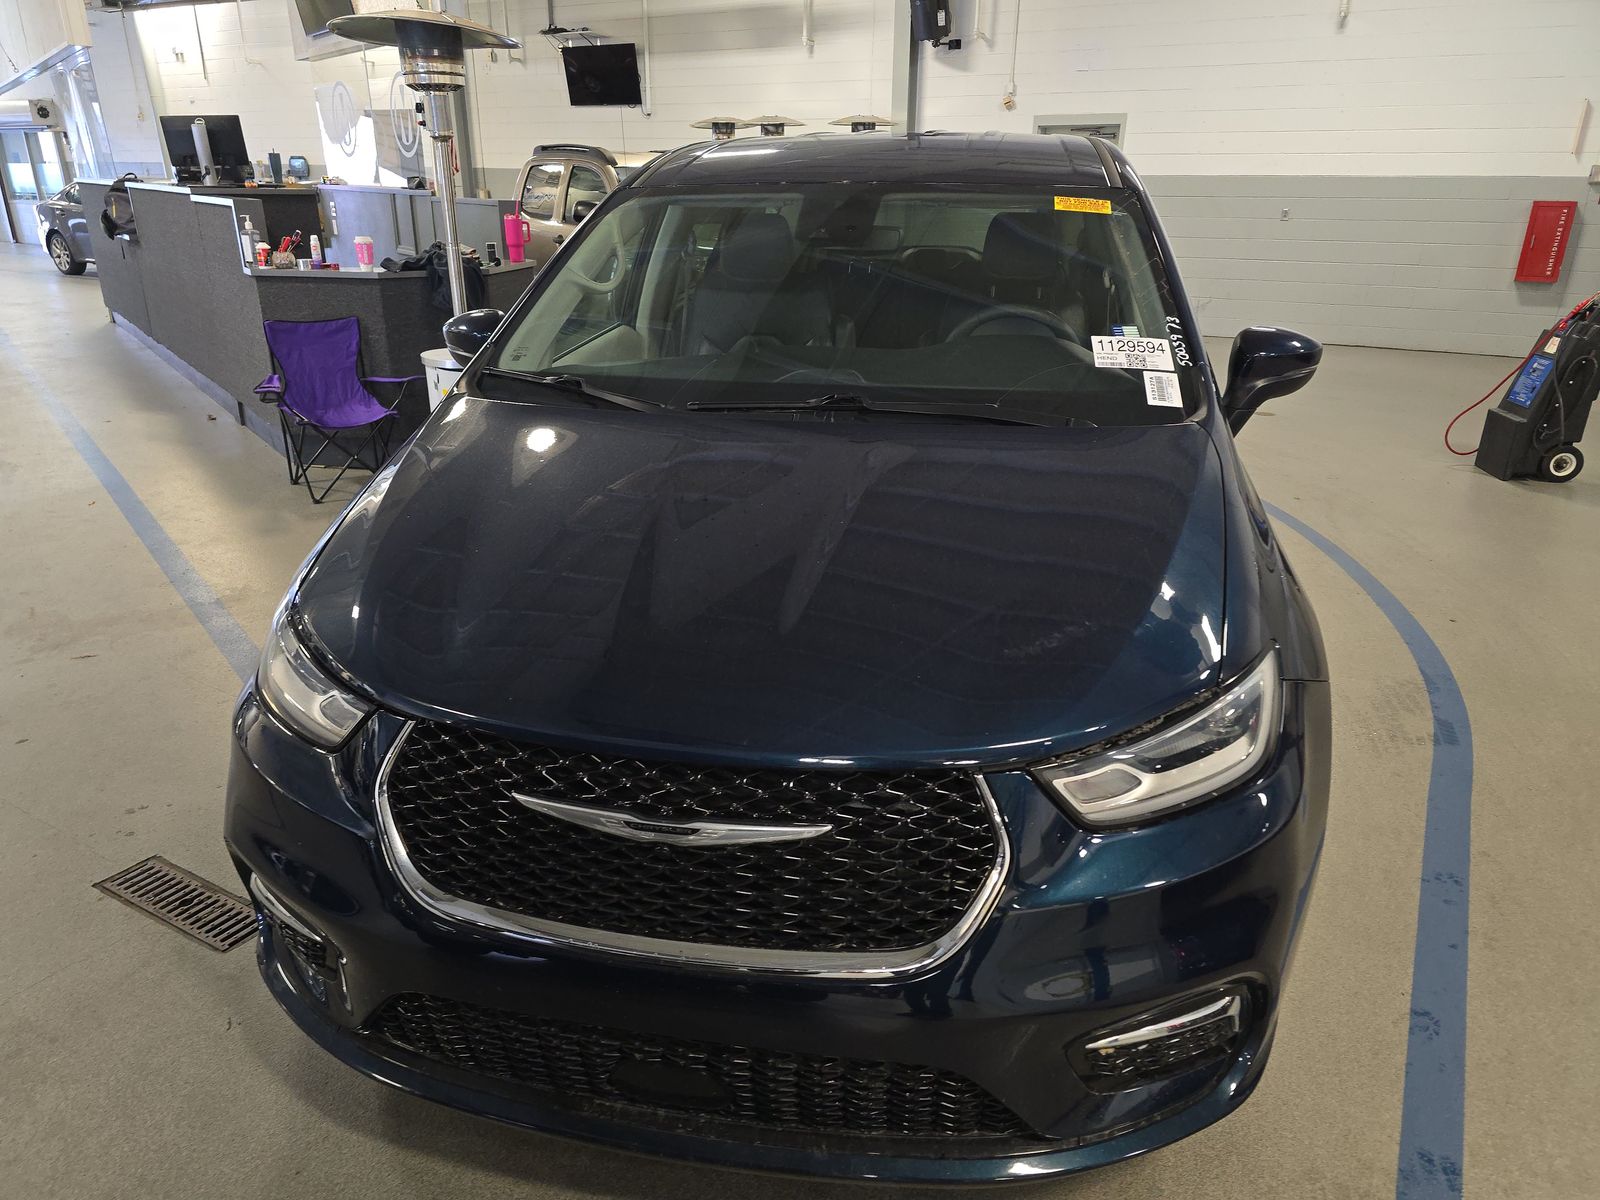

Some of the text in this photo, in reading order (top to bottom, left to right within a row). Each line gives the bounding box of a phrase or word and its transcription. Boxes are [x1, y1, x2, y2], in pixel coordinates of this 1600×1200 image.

[1545, 209, 1568, 276] FIRE EXTINGUISHER
[1097, 339, 1166, 354] 1129594
